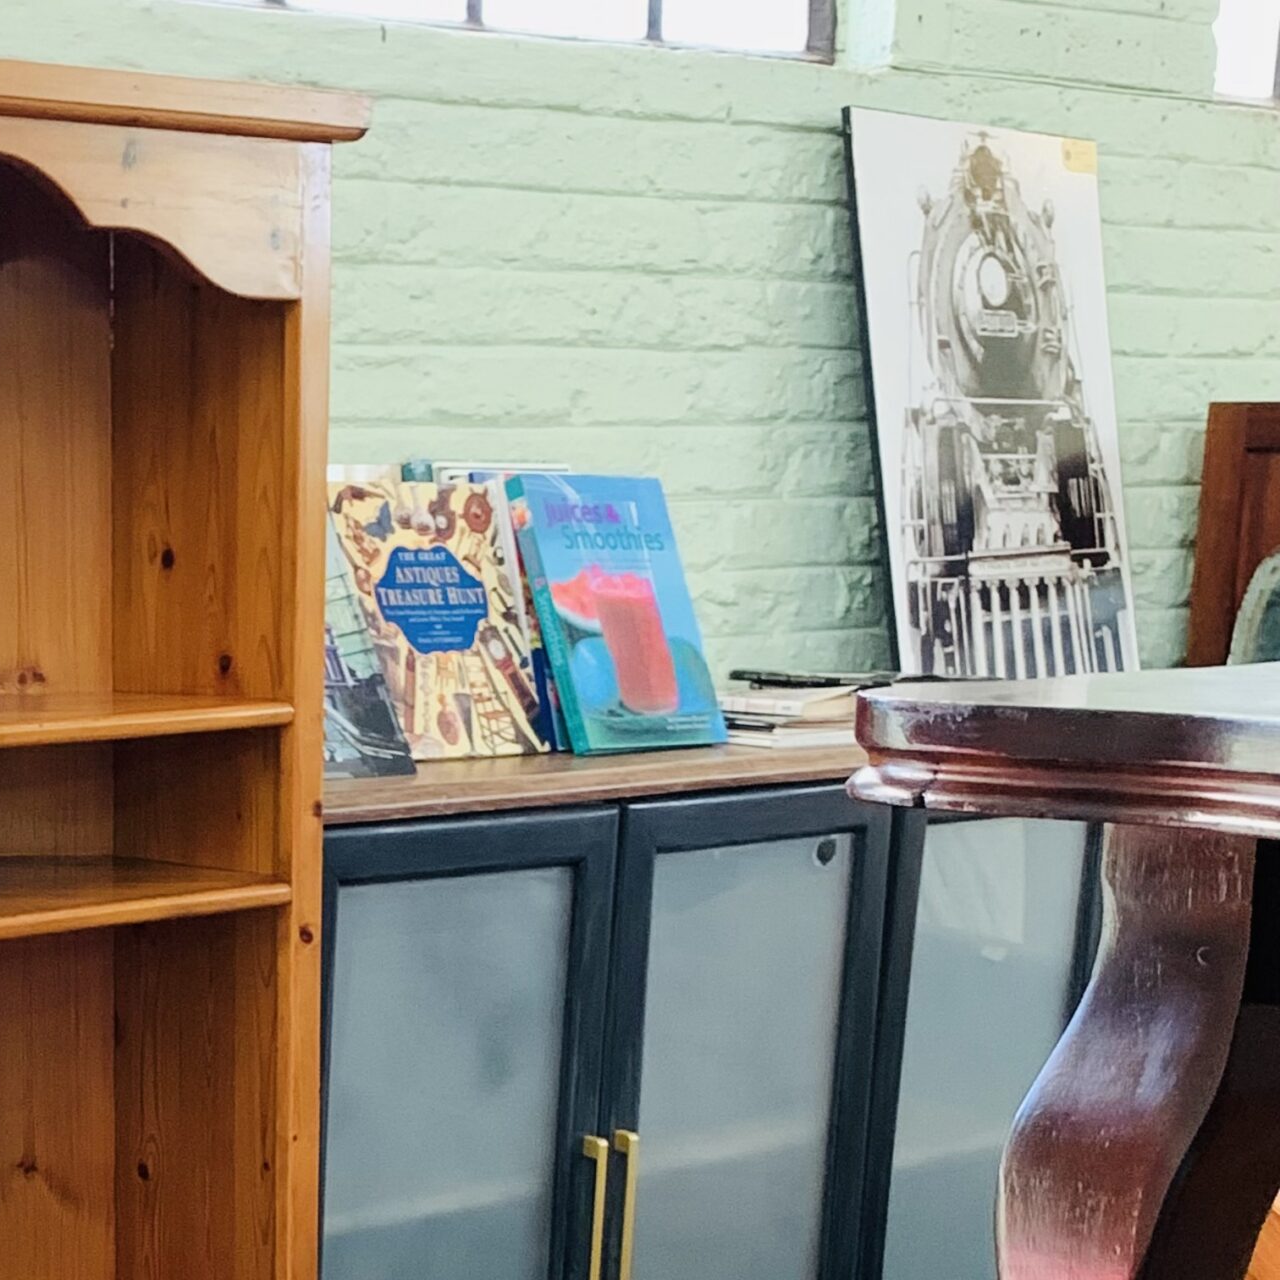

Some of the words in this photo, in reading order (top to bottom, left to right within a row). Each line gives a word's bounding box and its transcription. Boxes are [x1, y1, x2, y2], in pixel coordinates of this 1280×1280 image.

[544, 499, 601, 527] Juices
[561, 524, 664, 551] Smoothies
[398, 552, 415, 561] THE
[418, 552, 446, 561] GREAT
[395, 566, 460, 587] ANTIQUES
[377, 587, 445, 606] TREASURE
[447, 586, 484, 605] HUNT
